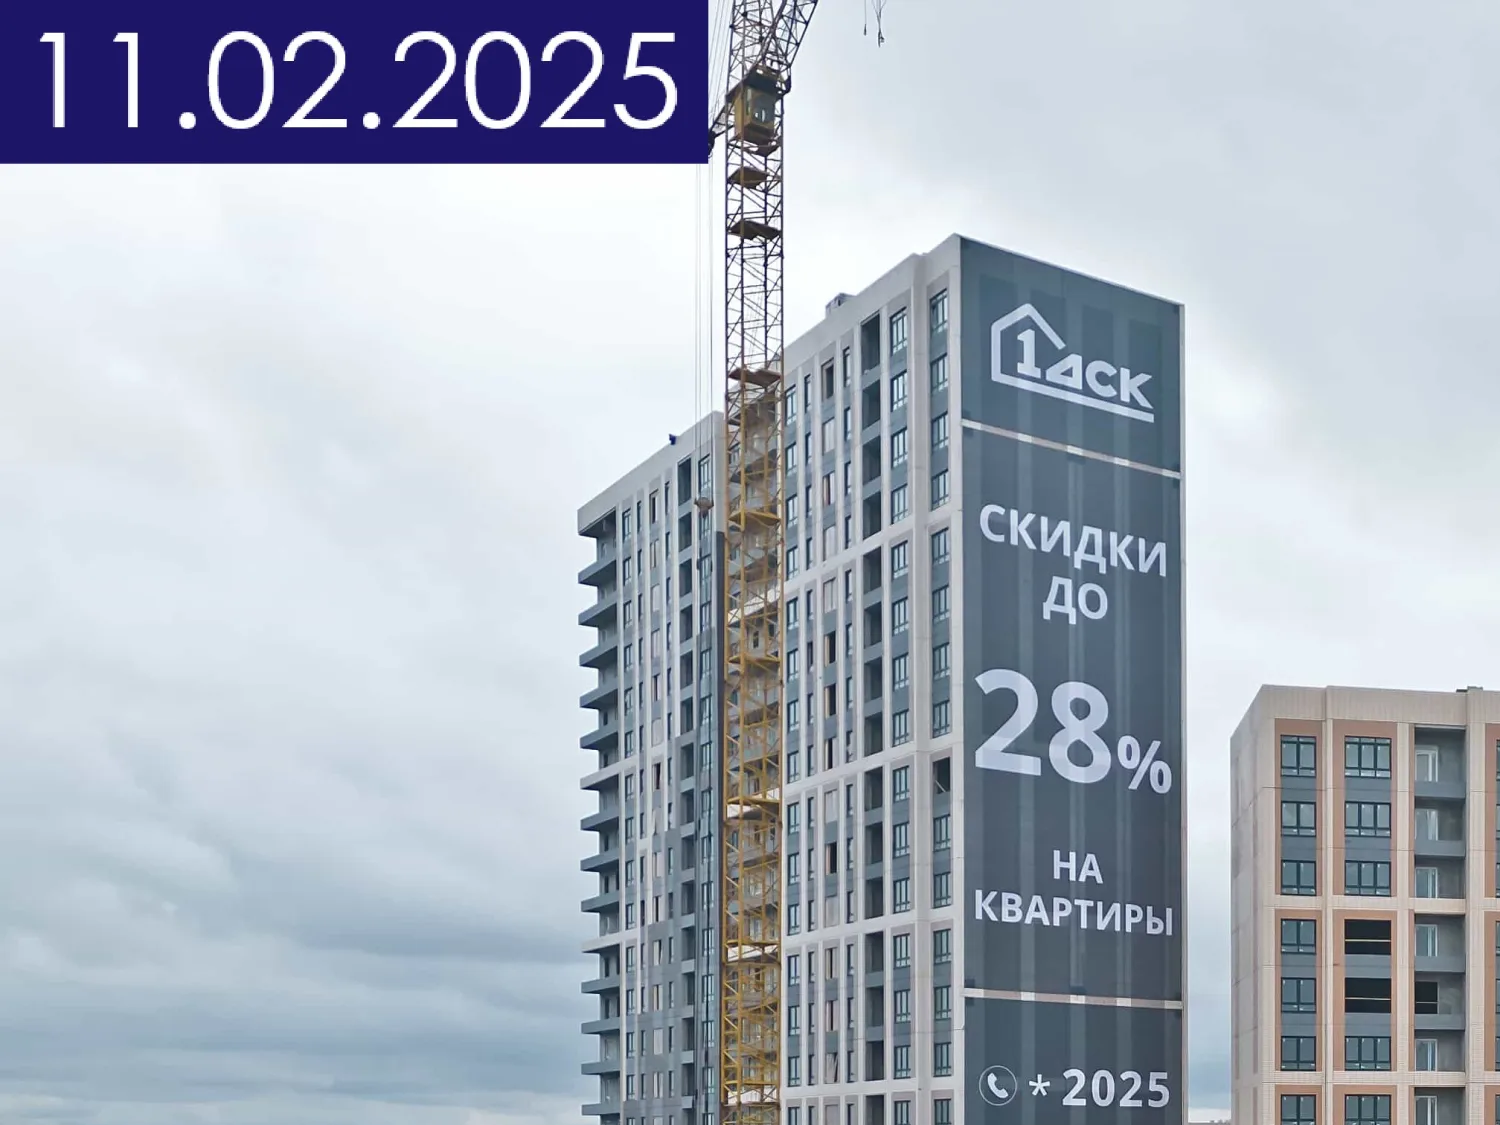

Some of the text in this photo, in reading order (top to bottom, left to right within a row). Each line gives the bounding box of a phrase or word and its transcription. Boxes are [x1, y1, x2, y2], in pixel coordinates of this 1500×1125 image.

[979, 504, 1168, 578] СКИДКИ
[1042, 575, 1108, 625] ДО
[975, 668, 1173, 794] 28%
[1053, 849, 1104, 885] НА
[974, 889, 1174, 936] КВАРТИРЫ
